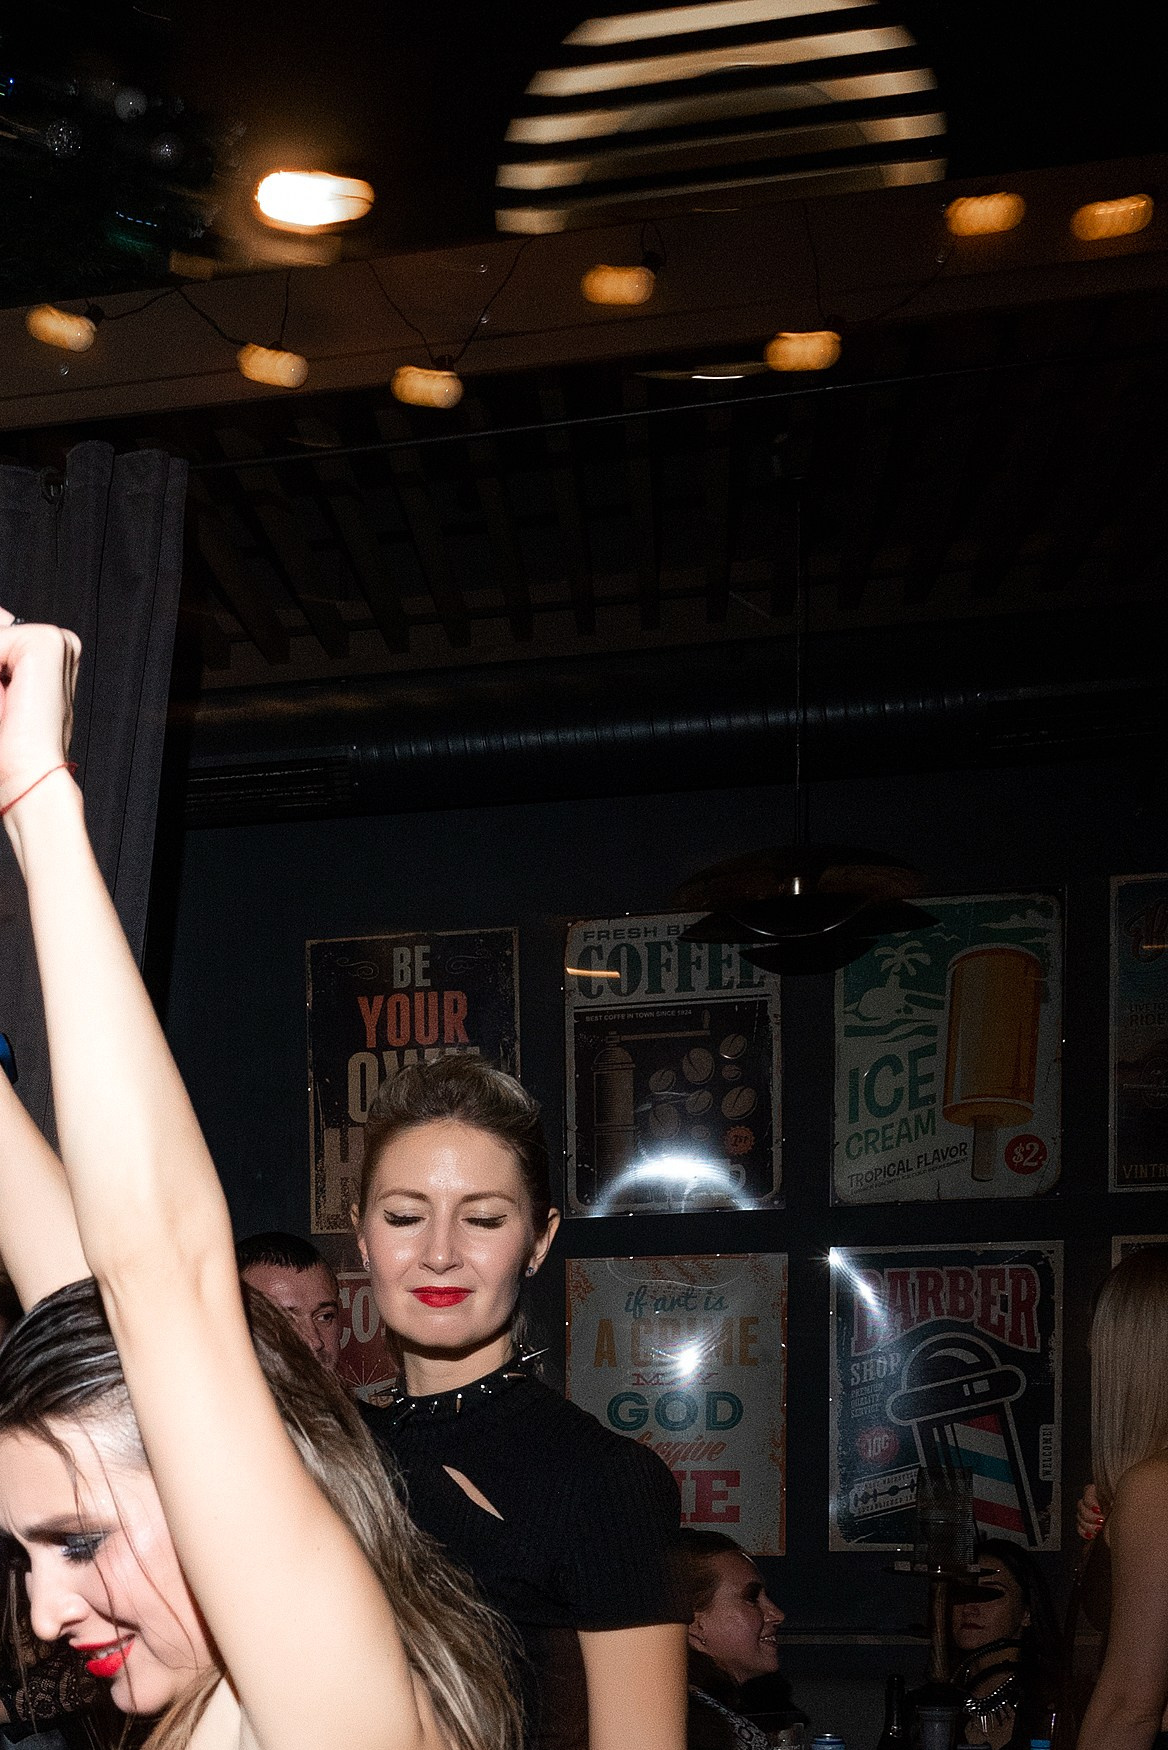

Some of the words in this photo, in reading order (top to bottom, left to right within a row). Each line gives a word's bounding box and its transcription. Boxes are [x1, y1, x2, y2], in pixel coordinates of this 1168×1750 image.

[583, 926, 658, 942] FRESH
[392, 945, 432, 989] BE
[356, 989, 470, 1050] YOUR
[585, 1015, 603, 1023] BEST
[627, 1012, 634, 1020] IN
[635, 1011, 655, 1019] TOWN
[656, 1009, 676, 1017] SINCE
[848, 1042, 938, 1125] ICE
[845, 1108, 937, 1161] CREAM
[848, 1158, 914, 1189] TROPICAL
[917, 1142, 969, 1170] FLAVOR
[624, 1285, 650, 1319] if
[653, 1288, 697, 1314] art
[703, 1292, 729, 1312] is
[851, 1264, 1041, 1357] BARBER
[593, 1318, 618, 1368] A
[850, 1353, 901, 1387] SHOP
[607, 1391, 744, 1432] GOD
[1042, 1428, 1053, 1478] WELCOME!
[672, 1470, 741, 1523] E
